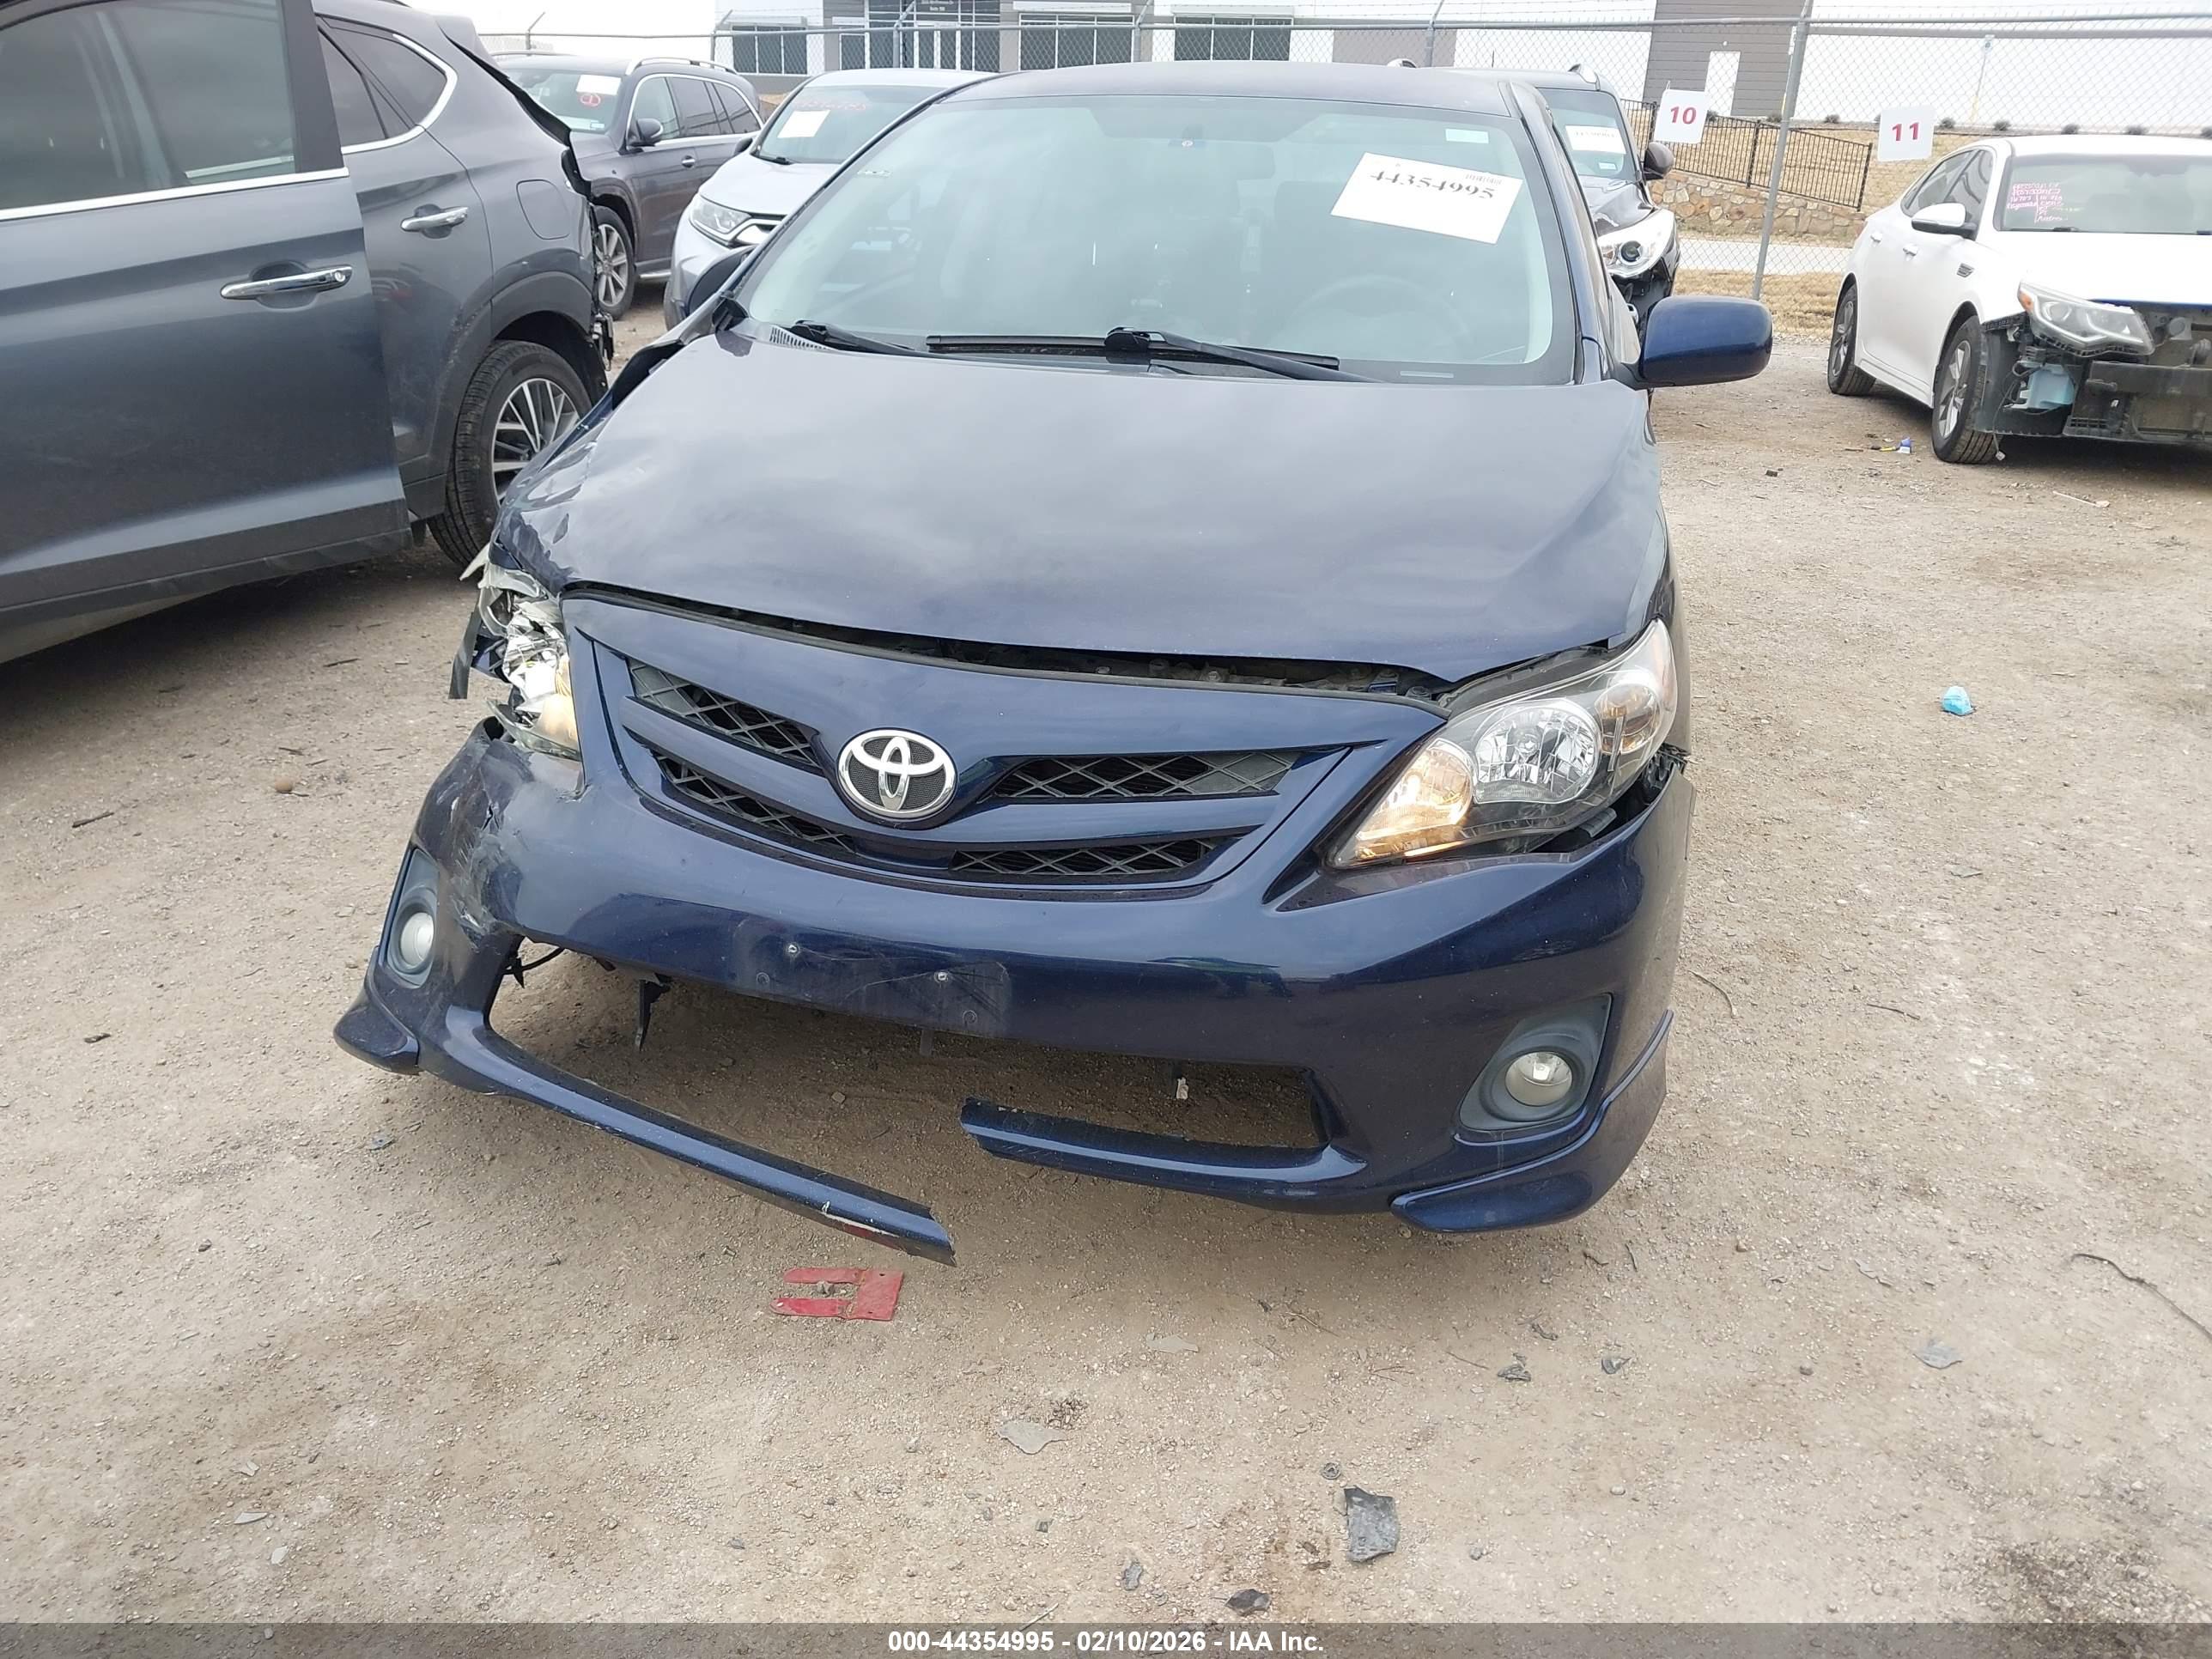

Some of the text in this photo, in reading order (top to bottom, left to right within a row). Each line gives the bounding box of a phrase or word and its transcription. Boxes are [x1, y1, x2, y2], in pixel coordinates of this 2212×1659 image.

[1670, 106, 1697, 125] 10
[1892, 122, 1919, 142] 11
[1370, 171, 1495, 199] 44354995
